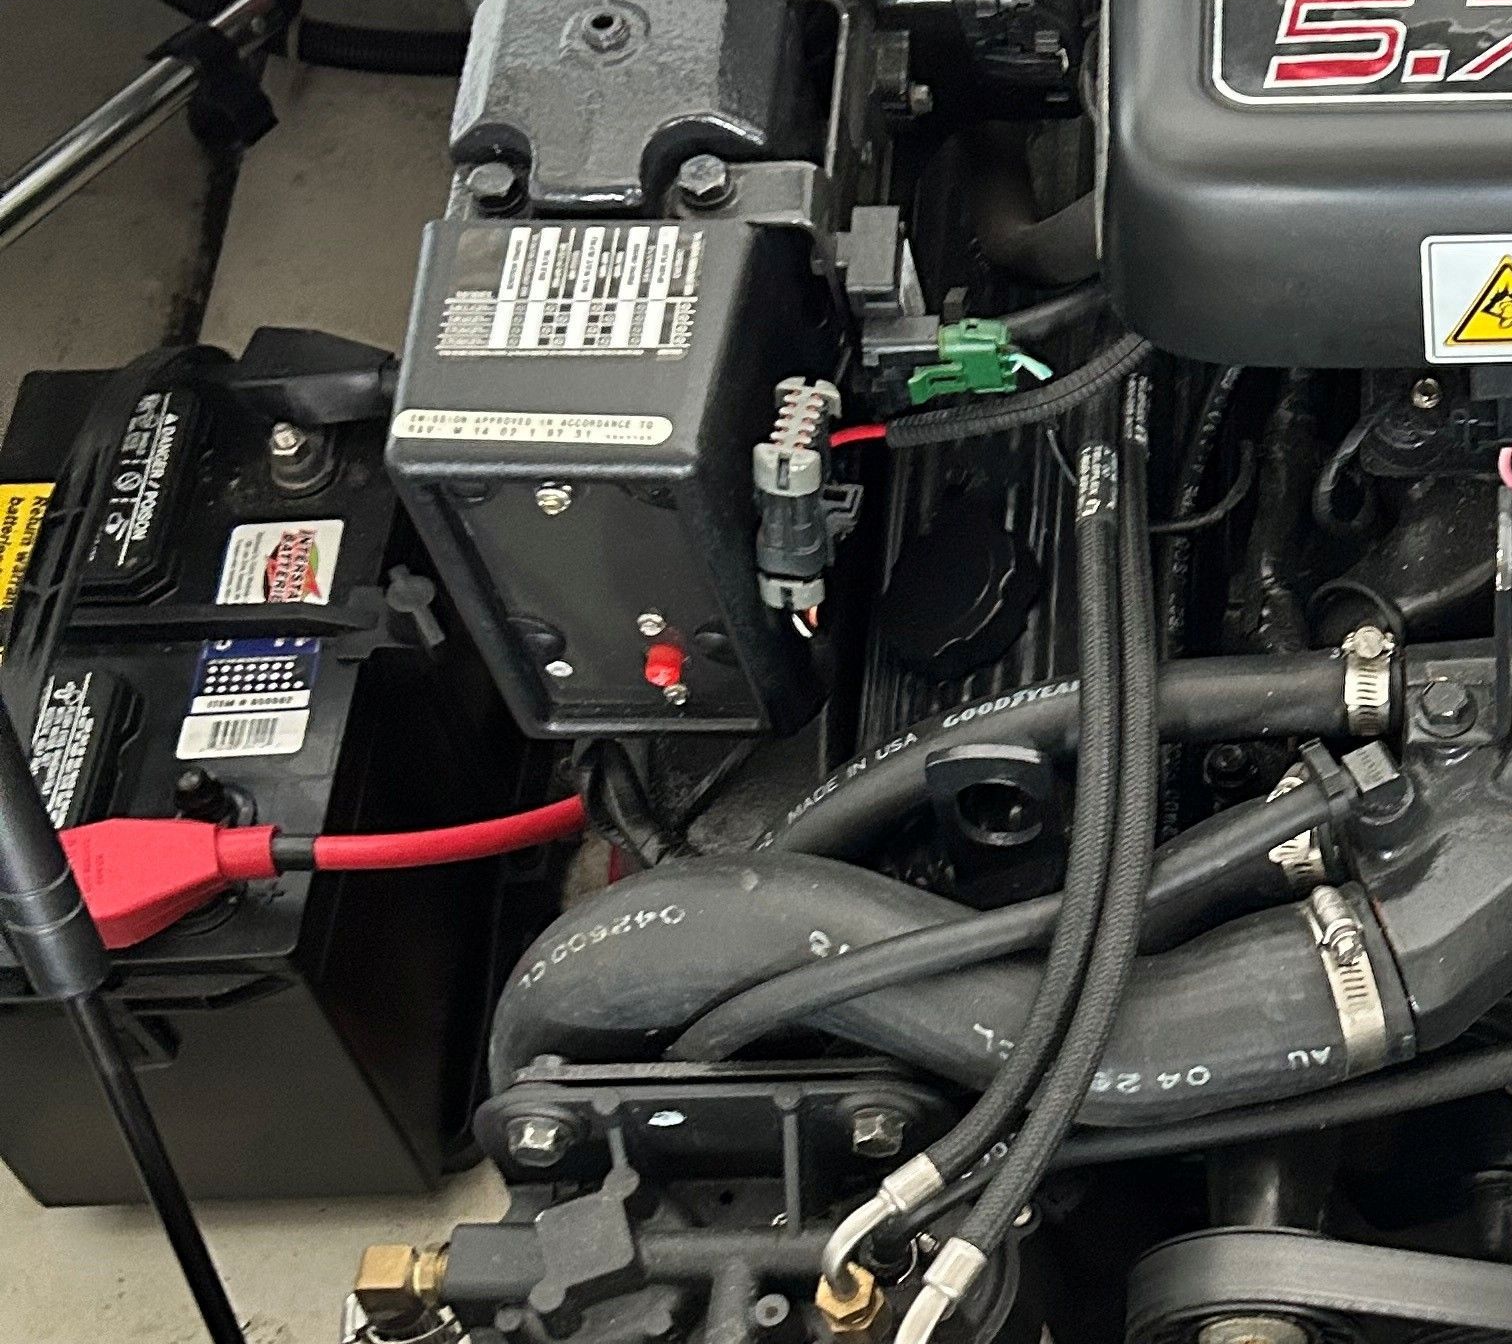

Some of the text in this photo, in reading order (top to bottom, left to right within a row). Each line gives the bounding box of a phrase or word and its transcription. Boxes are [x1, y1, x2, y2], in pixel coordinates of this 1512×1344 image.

[410, 414, 467, 423] EMISSION
[474, 416, 531, 426] APPROVED
[561, 419, 631, 429] ACCORDANCE
[640, 420, 654, 429] TO
[268, 530, 301, 603] BATTERIE
[286, 528, 318, 602] INTERSTA
[787, 775, 840, 825] MADE
[847, 757, 868, 779] IN
[875, 732, 919, 761] USA
[1157, 1066, 1211, 1090] 04
[1287, 1046, 1331, 1070] AU
